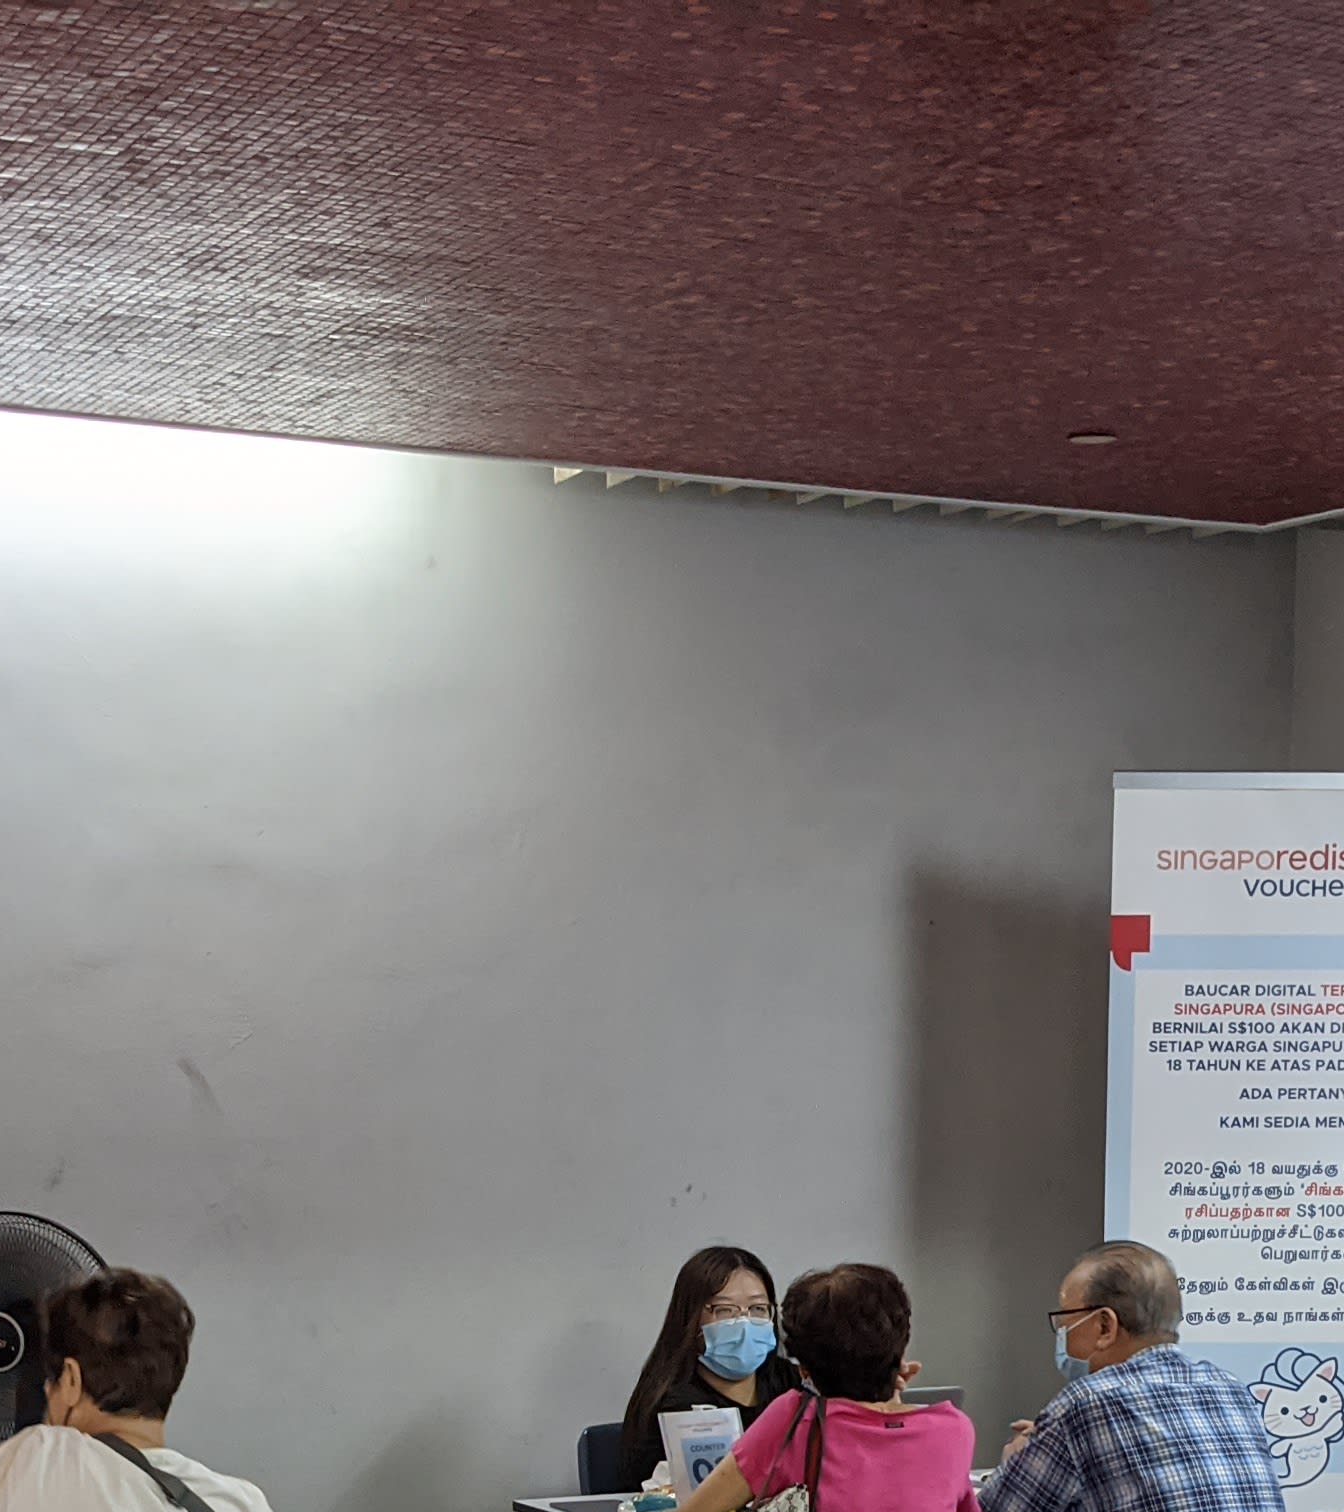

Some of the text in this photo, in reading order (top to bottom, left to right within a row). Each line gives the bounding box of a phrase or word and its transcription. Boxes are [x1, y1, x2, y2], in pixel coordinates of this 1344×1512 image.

[1185, 984, 1250, 996] BAUCAR
[1255, 985, 1316, 996] DIGITAL
[1174, 1003, 1265, 1015] SINGAPURA
[1153, 1022, 1223, 1034] BERNILAI
[1228, 1021, 1275, 1034] S$100
[1280, 1022, 1325, 1034] AKAN
[1149, 1041, 1203, 1052] SETIAP
[1208, 1041, 1268, 1052] WARGA
[1167, 1059, 1182, 1071] 18
[1186, 1059, 1240, 1071] TAHUN
[1246, 1059, 1266, 1071] KE
[1270, 1059, 1310, 1071] ATAS
[1239, 1088, 1272, 1099] ADA
[1220, 1116, 1259, 1128] KAMI
[1264, 1116, 1310, 1128] SEDIA
[1248, 1162, 1265, 1175] 18
[1296, 1204, 1344, 1220] S$100
[690, 1443, 726, 1453] COUNTER
[693, 1456, 724, 1484] 0
